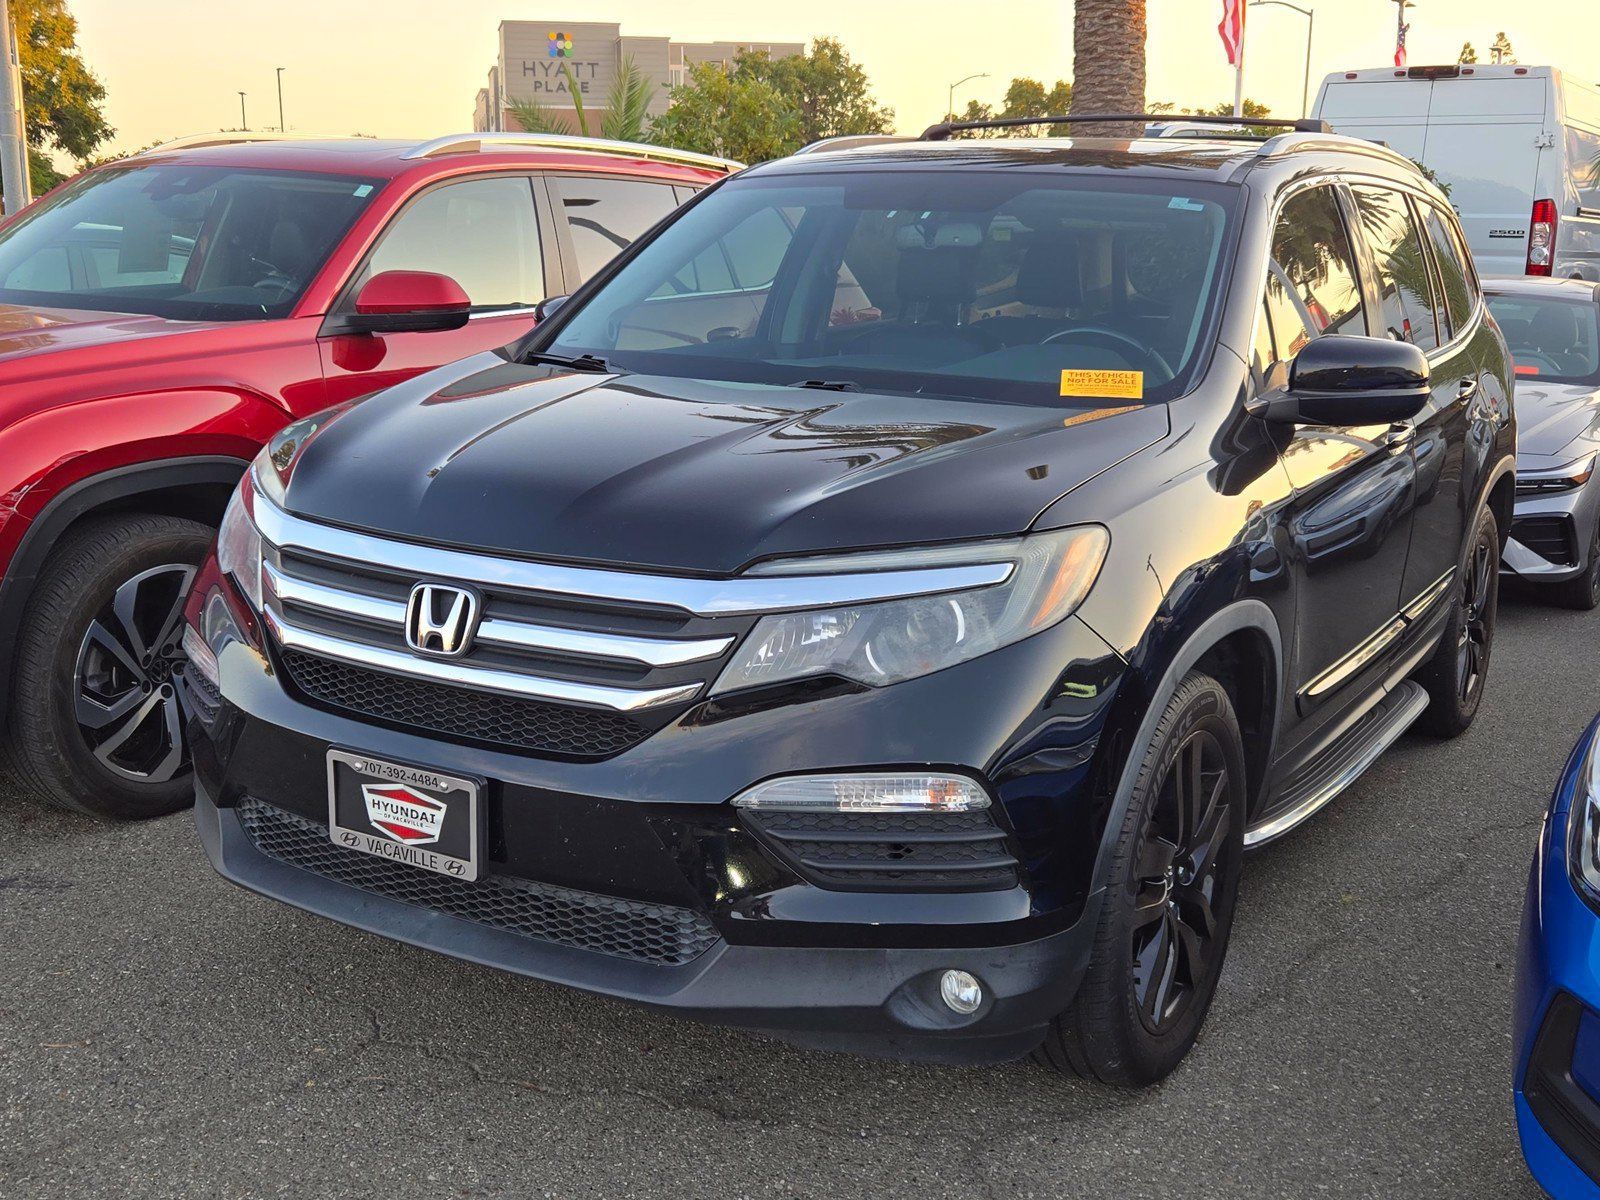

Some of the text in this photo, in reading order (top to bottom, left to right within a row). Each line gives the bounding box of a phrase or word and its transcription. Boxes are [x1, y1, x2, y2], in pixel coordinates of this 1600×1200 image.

[522, 60, 599, 78] HYATT
[362, 760, 439, 788] 707-392-4484
[371, 798, 436, 825] HYUNDAI
[393, 814, 424, 828] VACAVILLE
[366, 837, 438, 870] VACAVILLE
